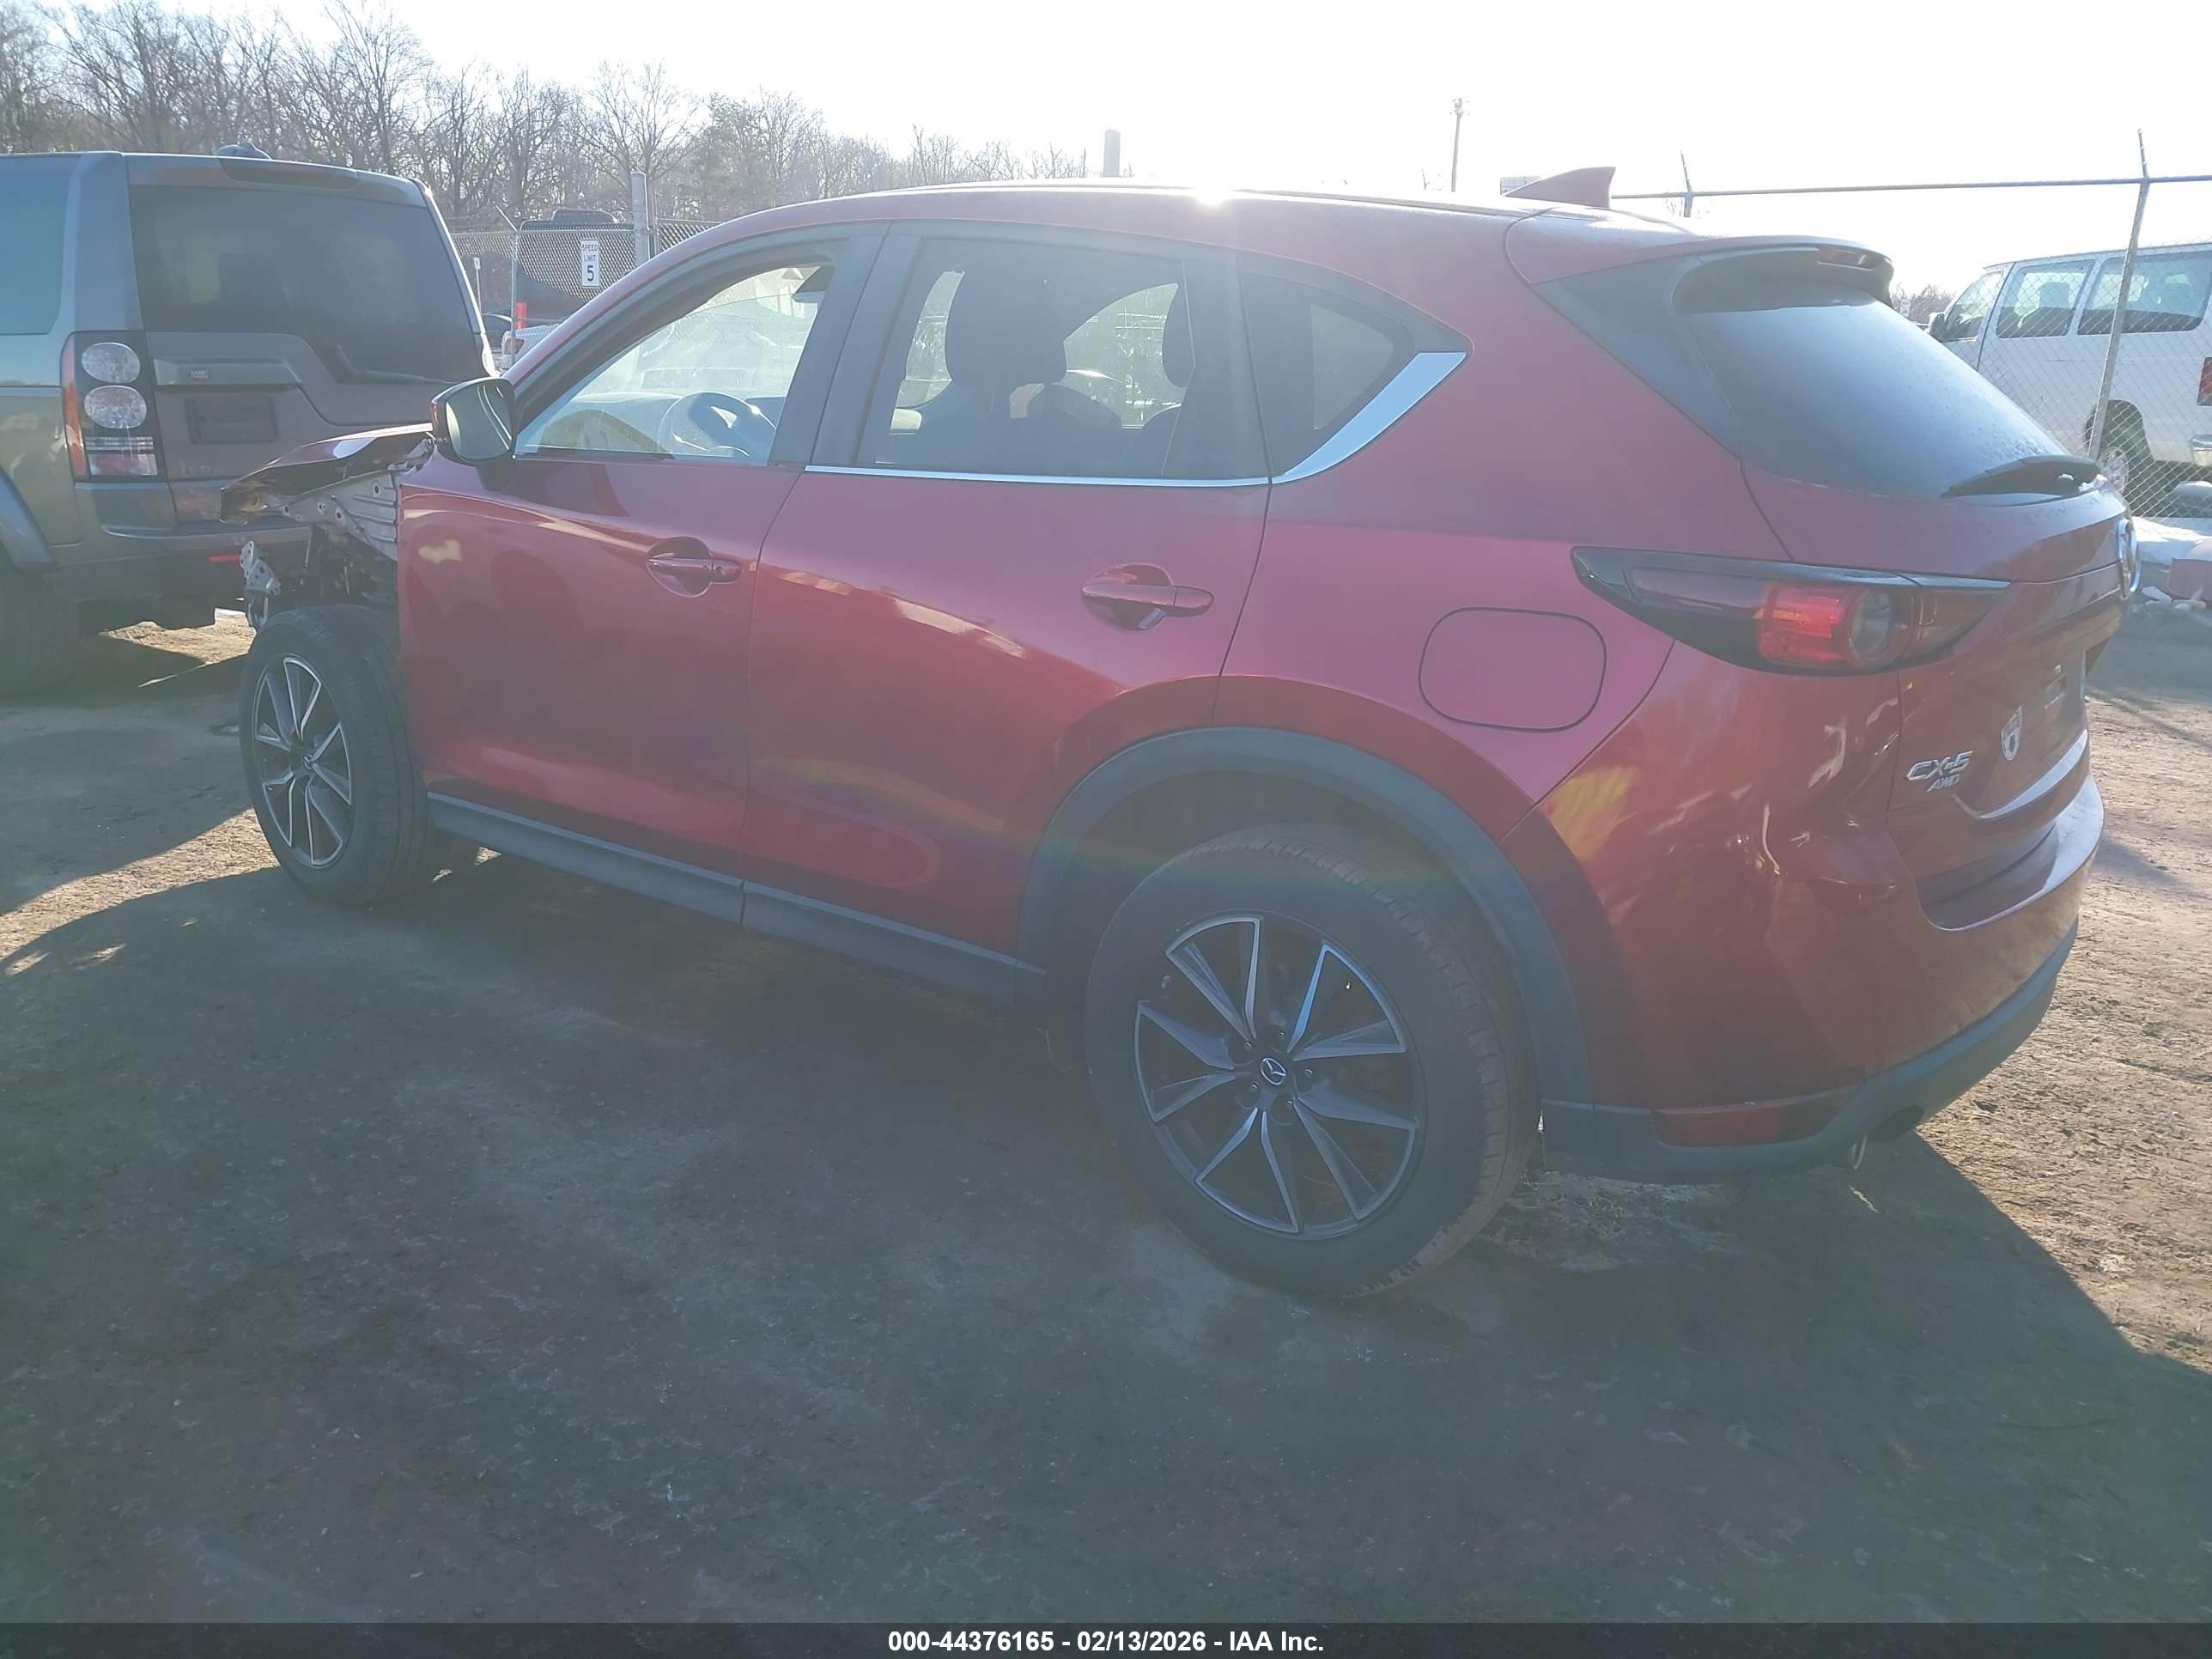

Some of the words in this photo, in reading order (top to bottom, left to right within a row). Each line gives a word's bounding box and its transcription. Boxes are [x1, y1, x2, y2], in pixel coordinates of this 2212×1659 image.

[586, 264, 595, 283] 5
[1905, 750, 1974, 781] CX-5
[1926, 774, 1960, 793] AWD
